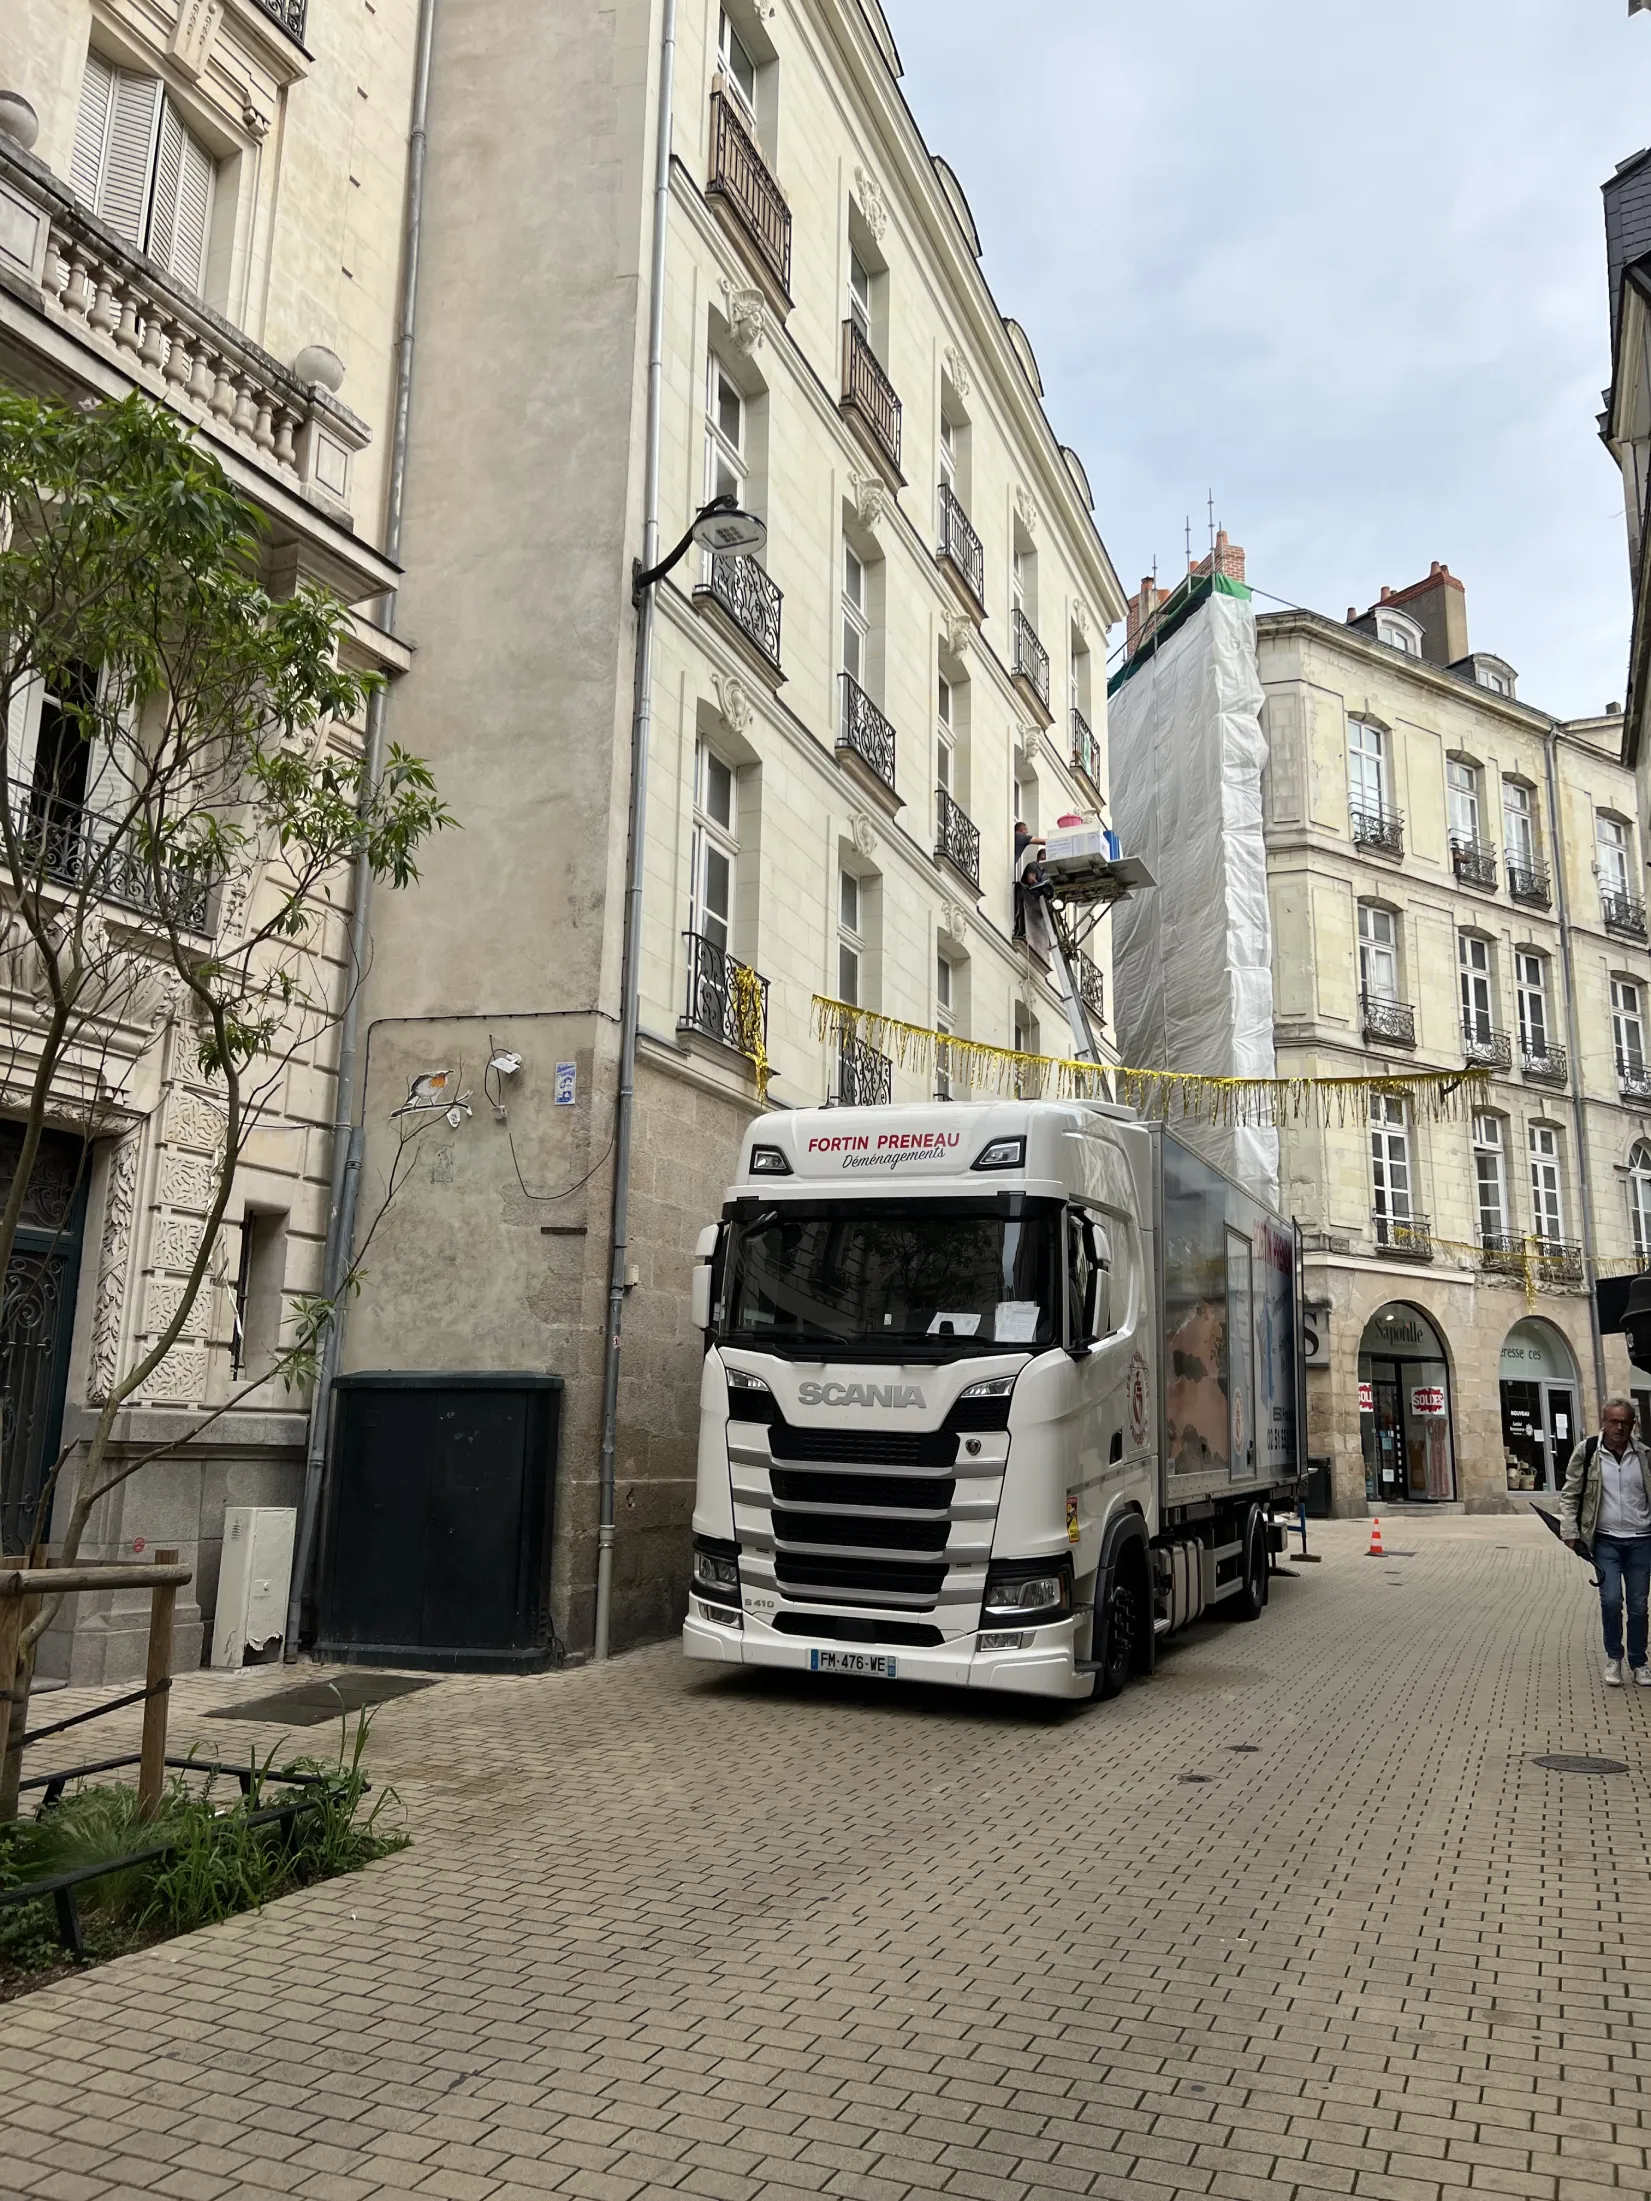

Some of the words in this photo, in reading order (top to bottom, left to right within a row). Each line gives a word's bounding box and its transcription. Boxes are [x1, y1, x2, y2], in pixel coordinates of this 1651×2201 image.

[808, 1136, 869, 1152] FORTIN
[877, 1132, 960, 1149] PRENEAU
[842, 1146, 946, 1170] Déménagements
[798, 1381, 927, 1408] SCANIA
[1413, 1393, 1443, 1406] SOLDES
[754, 1599, 775, 1608] 410
[820, 1652, 886, 1672] FM-476-WE
